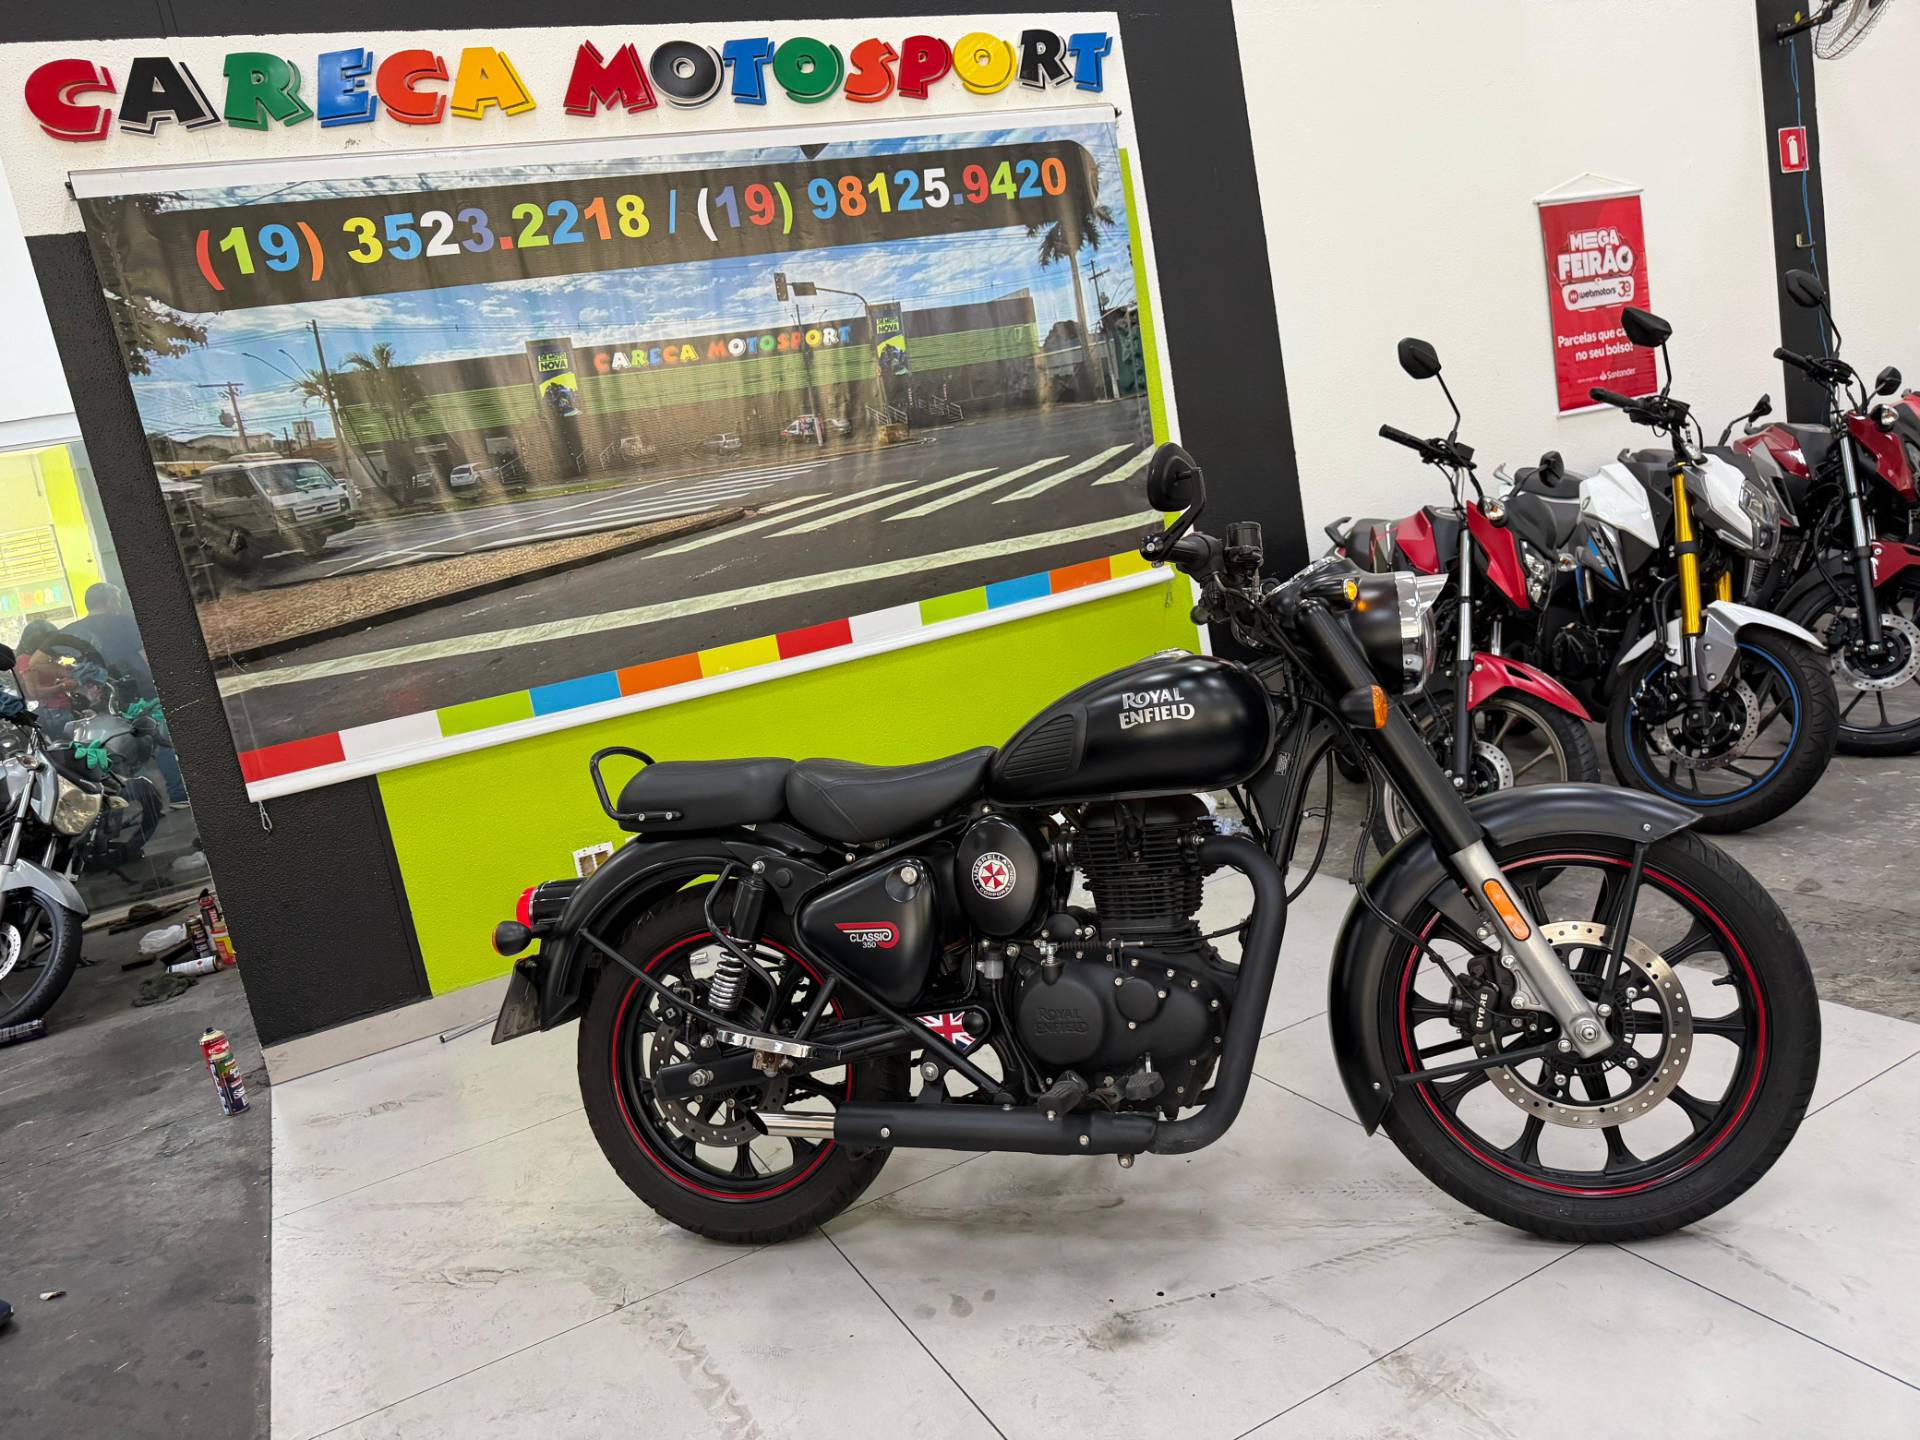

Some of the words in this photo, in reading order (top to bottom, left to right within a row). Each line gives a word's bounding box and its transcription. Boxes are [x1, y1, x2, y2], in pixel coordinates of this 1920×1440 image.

[24, 47, 537, 142] CARECA
[563, 29, 1113, 118] MOTOSPORT
[196, 221, 324, 291] (19)
[342, 194, 650, 264] 3523.2218
[669, 188, 677, 235] /
[697, 181, 793, 242] (19)
[807, 157, 1067, 221] 98125.9420
[1569, 229, 1619, 251] MEGA
[1557, 245, 1634, 280] FEIRÃO
[1579, 286, 1617, 299] webmotors
[1557, 331, 1598, 348] Parcelas
[1598, 329, 1616, 343] que
[593, 344, 699, 374] CARECA
[707, 326, 850, 358] MOTOSPORT
[1575, 350, 1588, 361] no
[1589, 348, 1605, 359] seu
[540, 360, 567, 371] NOVA
[1606, 367, 1636, 380] Santander
[1122, 687, 1185, 709] ROYAL
[1118, 703, 1195, 730] ENFIELD
[849, 930, 891, 942] CLASSIC
[862, 941, 877, 949] 350
